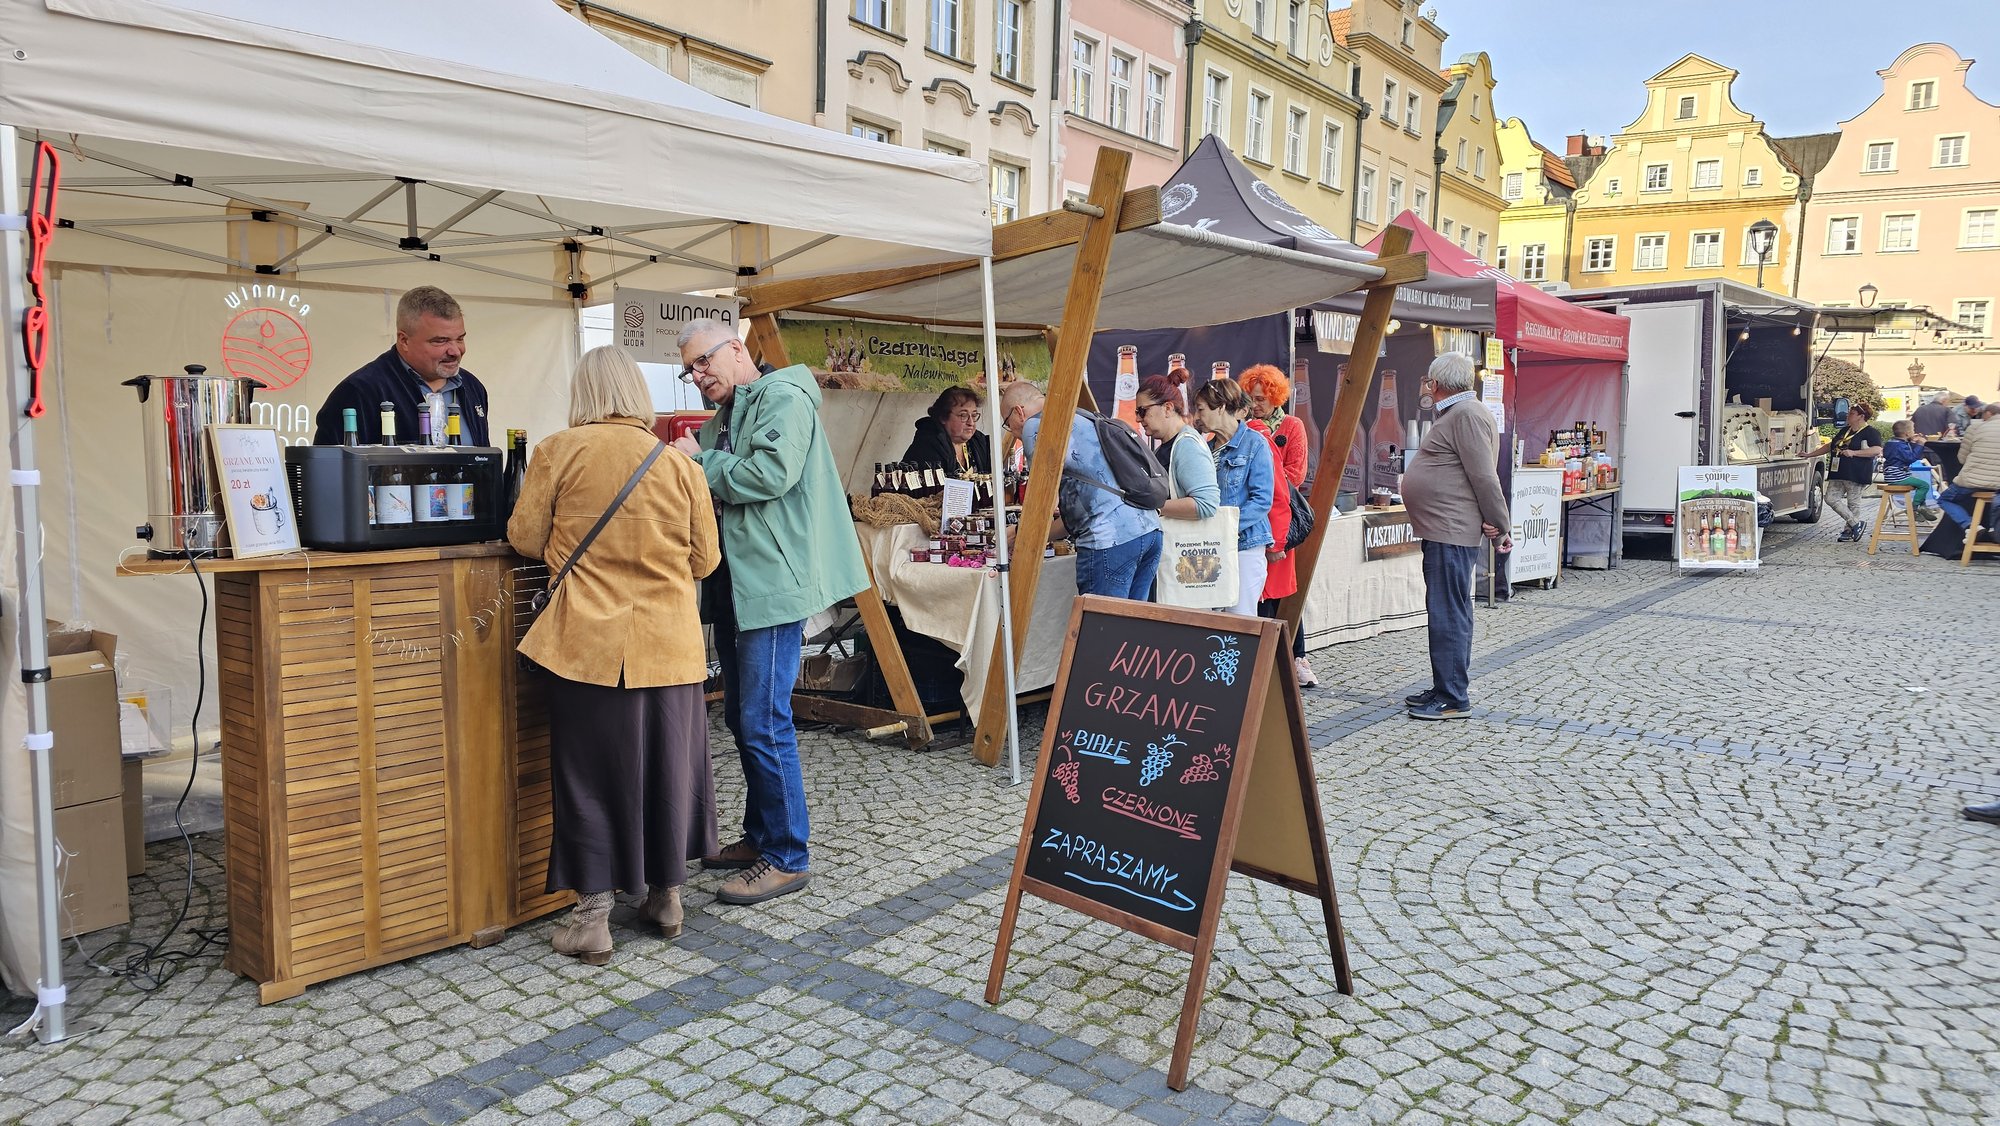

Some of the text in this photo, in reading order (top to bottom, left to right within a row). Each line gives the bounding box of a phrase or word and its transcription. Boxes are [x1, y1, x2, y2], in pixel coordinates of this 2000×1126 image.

[224, 284, 311, 316] WINNICA
[623, 329, 644, 338] ZIMNA
[1315, 312, 1342, 341] WINO
[1344, 315, 1360, 343] GR
[1451, 327, 1473, 357] PIWO
[1525, 321, 1562, 341] REGIONALNY
[1563, 329, 1587, 345] BROWAR
[623, 339, 644, 347] WODA
[250, 401, 309, 432] MNA
[223, 456, 275, 466] GRZANE WINO
[230, 479, 242, 490] 20
[1760, 467, 1806, 489] FISH FOOD TRUCK
[1367, 523, 1405, 548] KASZTANY
[1181, 547, 1217, 557] OSÓWKA
[1109, 641, 1196, 685] WINO
[1084, 682, 1216, 733] GRZANE
[1073, 729, 1130, 758] BIAŁE
[1102, 786, 1198, 832] CZERWONE
[1041, 828, 1179, 893] ZAPRASZAMY
